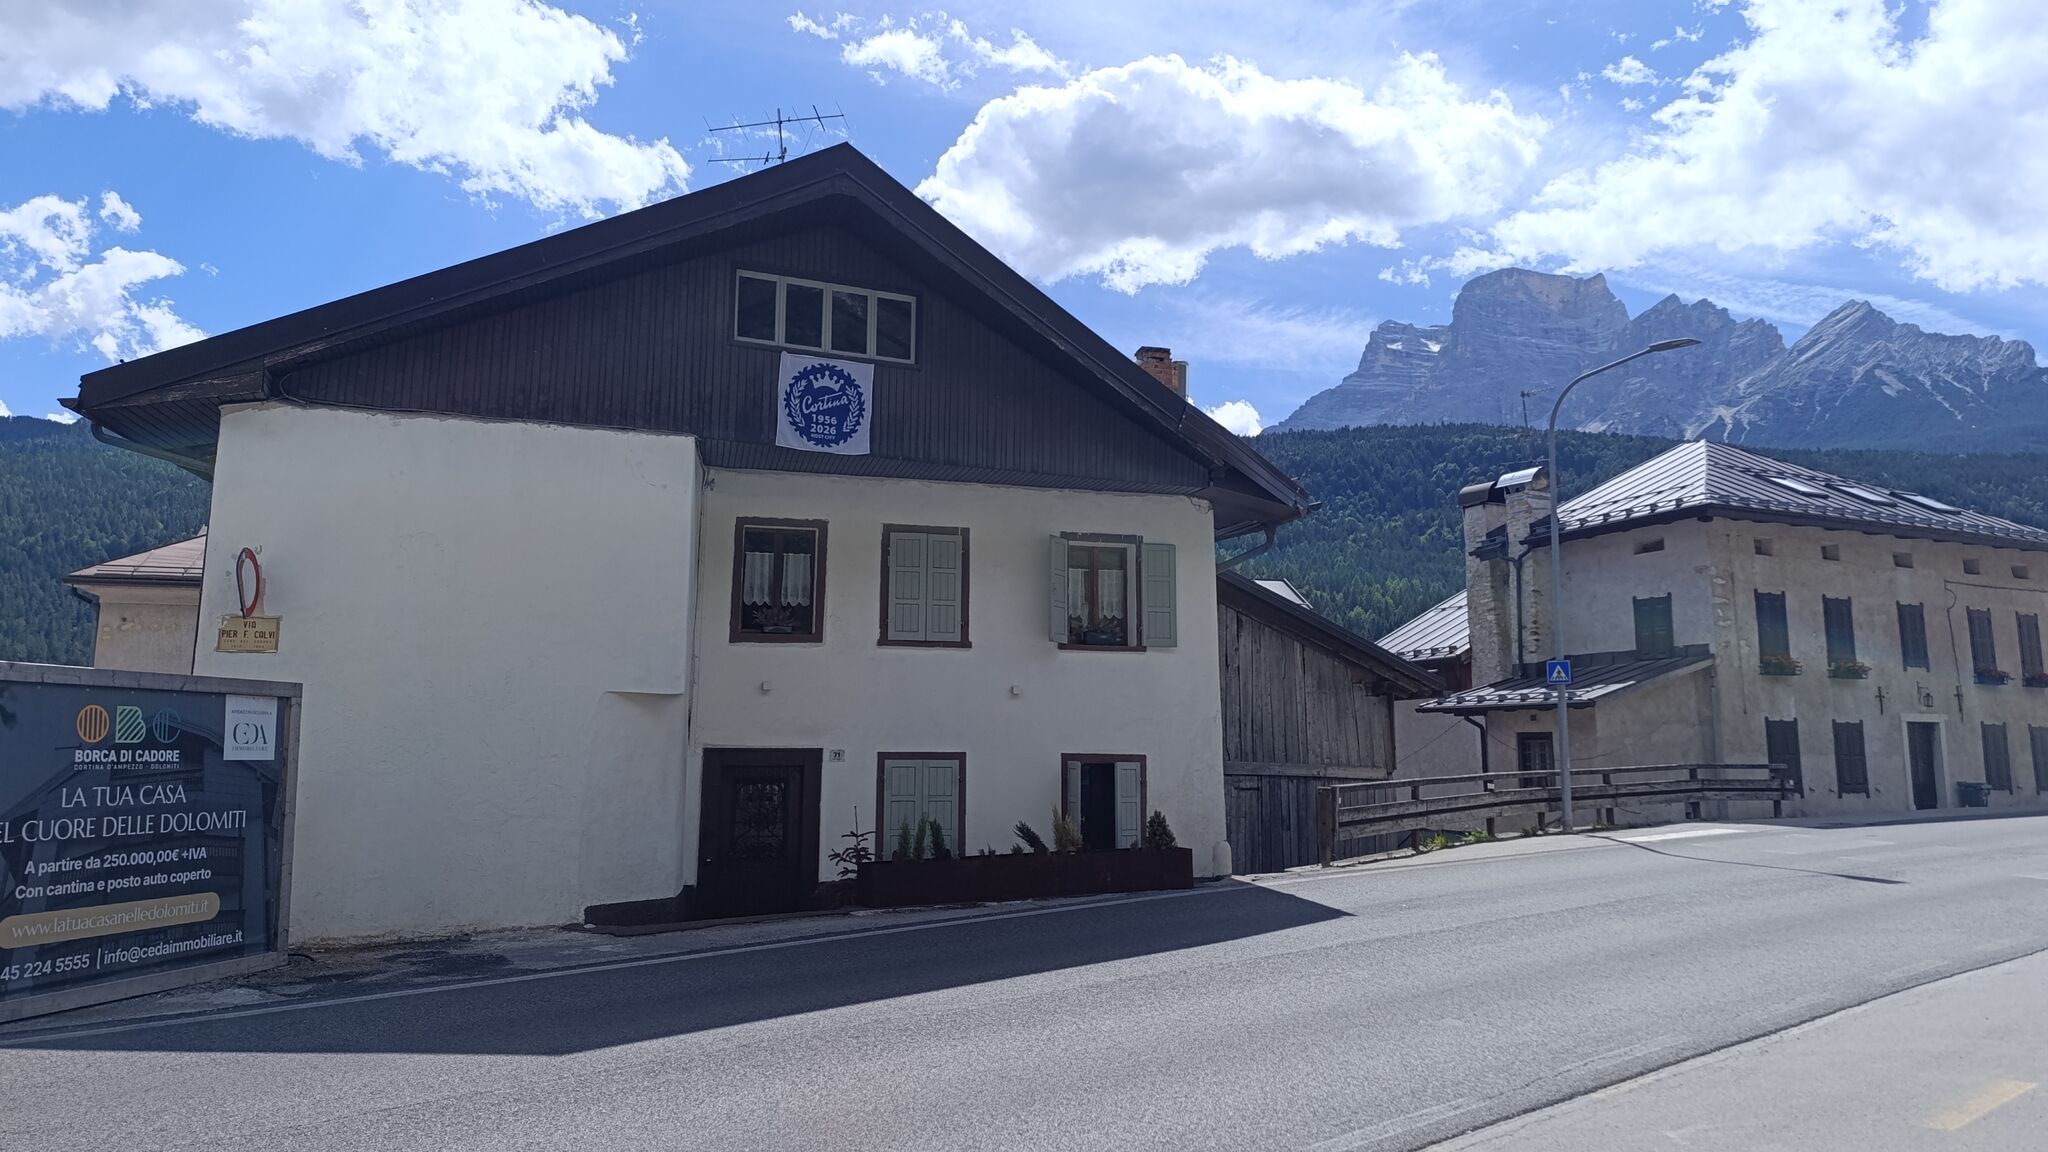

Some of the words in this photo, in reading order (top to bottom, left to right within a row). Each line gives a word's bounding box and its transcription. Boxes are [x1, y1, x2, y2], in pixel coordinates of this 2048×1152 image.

[802, 392, 849, 413] Cortina
[810, 423, 836, 435] 2026
[811, 414, 837, 425] 1956
[221, 630, 238, 638] PIER
[254, 631, 275, 639] CALVI
[74, 763, 104, 771] CORTINA
[75, 750, 117, 763] BORCA
[120, 750, 132, 762] DI
[135, 750, 180, 762] CADORE
[62, 787, 87, 808] LA
[92, 786, 134, 806] TUA
[140, 784, 187, 805] CASA
[21, 818, 97, 842] CUORE
[102, 814, 155, 837] DELLE
[160, 810, 246, 833] DOLOMITI
[24, 861, 35, 875] A
[38, 857, 82, 877] partire
[85, 856, 100, 869] da
[103, 849, 179, 868] 250.000,00€
[181, 847, 207, 860] +IVA
[15, 885, 43, 899] Con
[46, 880, 94, 896] cantina
[97, 880, 105, 890] e
[107, 875, 141, 893] posto
[143, 873, 168, 886] auto
[170, 868, 211, 884] coperto
[12, 898, 209, 938] www.latuacasanelledolomiti.it
[23, 960, 51, 978] 224
[55, 954, 90, 973] 5555
